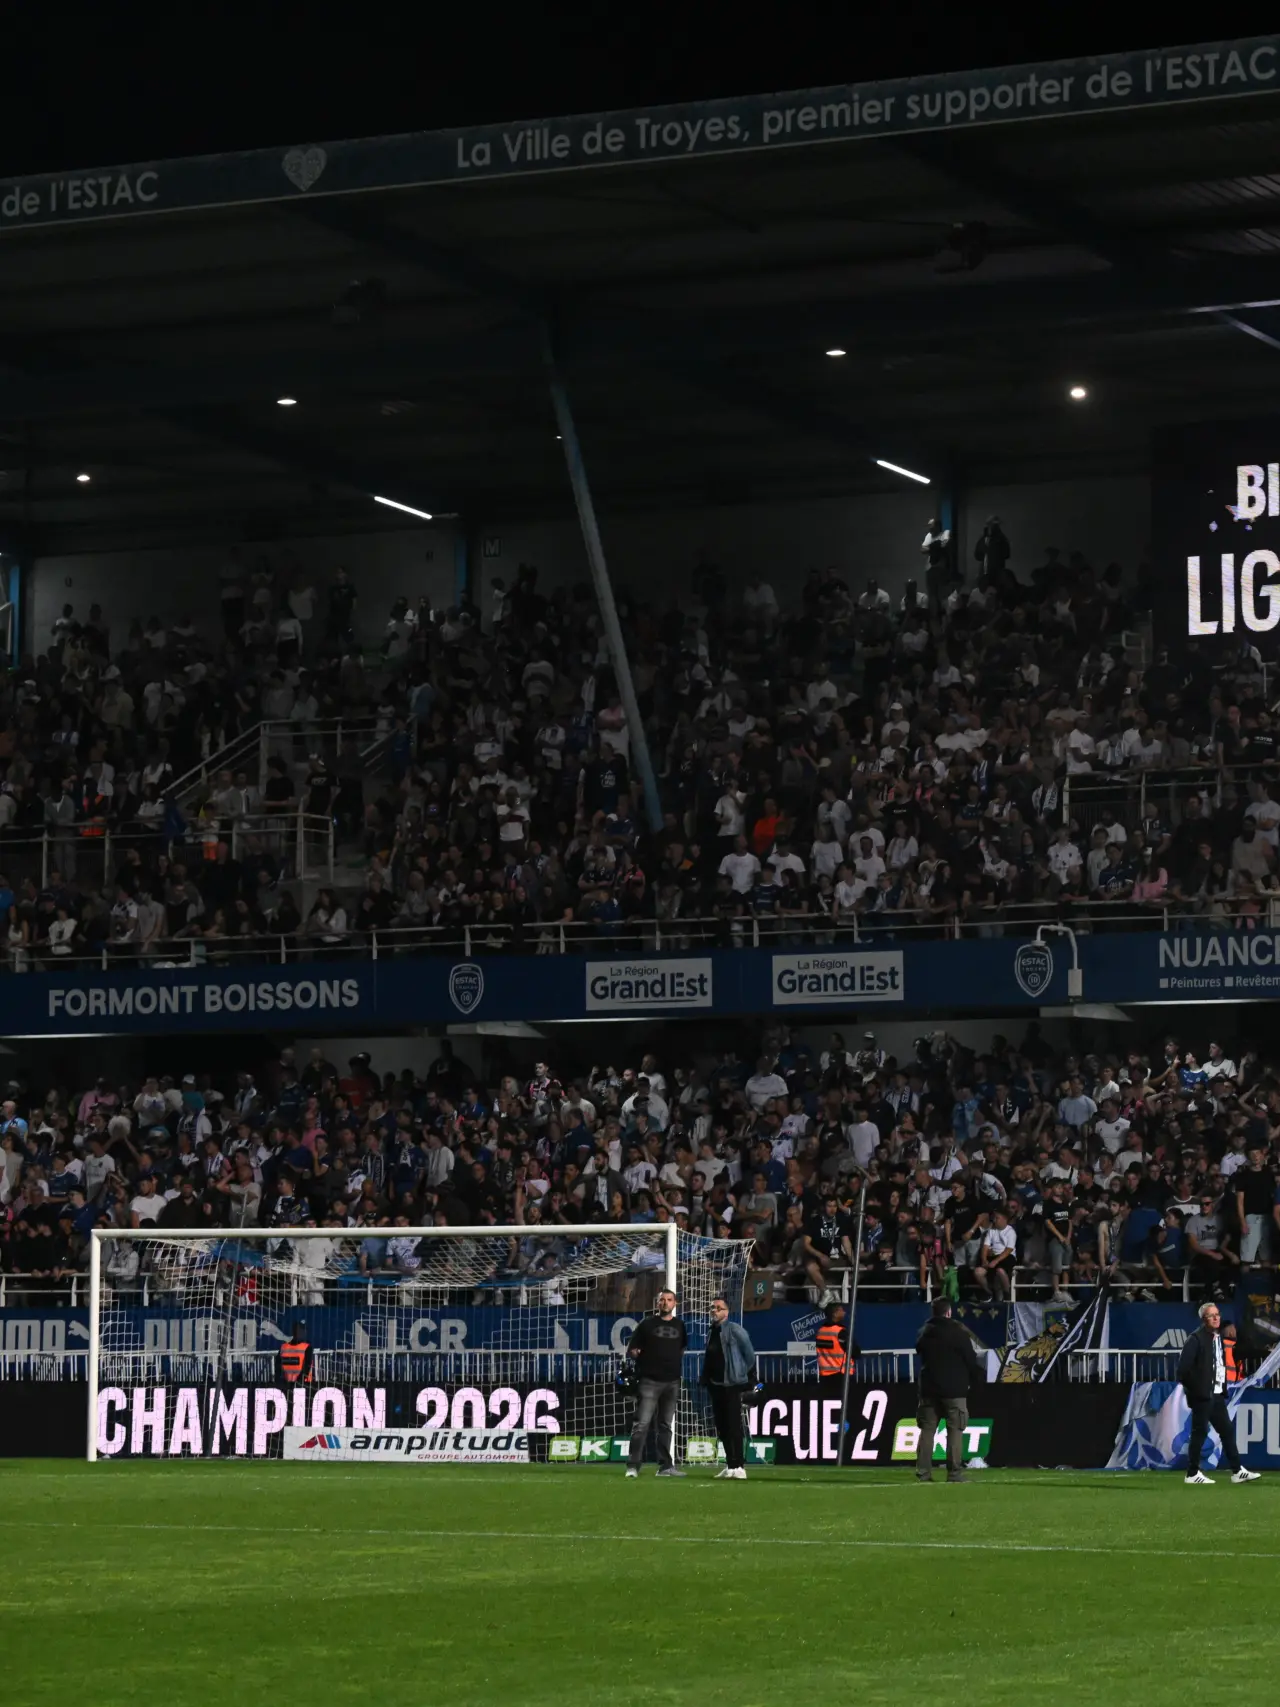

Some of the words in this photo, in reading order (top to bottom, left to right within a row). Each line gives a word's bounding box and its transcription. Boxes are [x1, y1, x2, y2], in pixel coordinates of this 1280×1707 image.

[457, 138, 490, 168] La
[503, 128, 570, 163] Ville
[582, 123, 625, 156] de
[635, 114, 750, 152] Troyes,
[762, 94, 896, 142] premier
[906, 73, 1075, 124] supporter
[1085, 66, 1132, 98] de
[1145, 46, 1277, 93] l'ESTAC
[2, 186, 40, 217] de
[50, 171, 159, 212] l'ESTAC
[610, 967, 622, 977] La
[625, 965, 659, 978] Région
[797, 960, 810, 970] La
[812, 958, 848, 972] Région
[1170, 976, 1221, 989] Peintures
[49, 986, 198, 1017] FORMONT
[205, 979, 359, 1013] BOISSONS
[794, 1311, 827, 1331] McArthu
[386, 1318, 468, 1352] LCR
[797, 1329, 815, 1340] Glen
[96, 1387, 388, 1456] CHAMPION
[415, 1386, 561, 1433] 2026
[851, 1389, 888, 1460] 2
[350, 1431, 529, 1455] amplitude
[687, 1441, 774, 1459] BT
